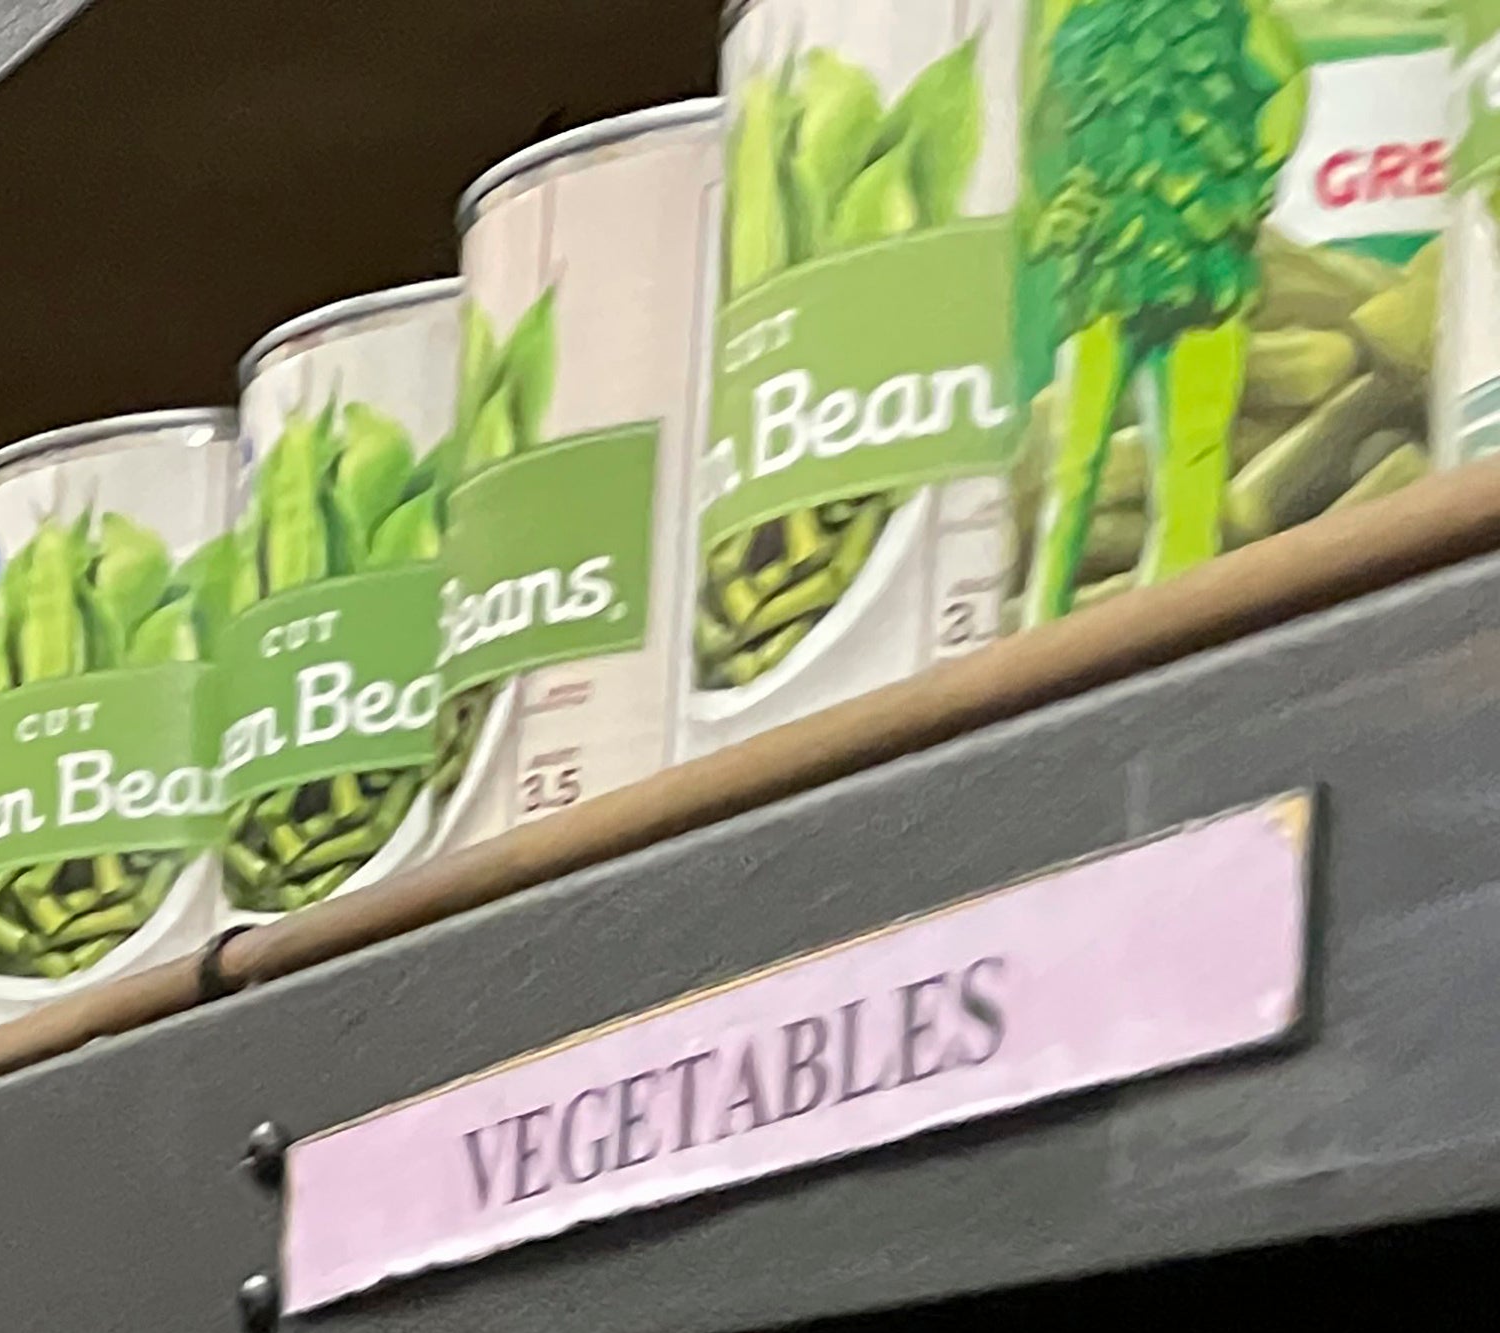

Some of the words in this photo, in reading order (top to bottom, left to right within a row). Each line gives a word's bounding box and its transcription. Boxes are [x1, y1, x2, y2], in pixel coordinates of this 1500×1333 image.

[260, 610, 342, 658] CUT
[15, 702, 102, 742] CUT
[462, 956, 1008, 1207] VEGETABLES
